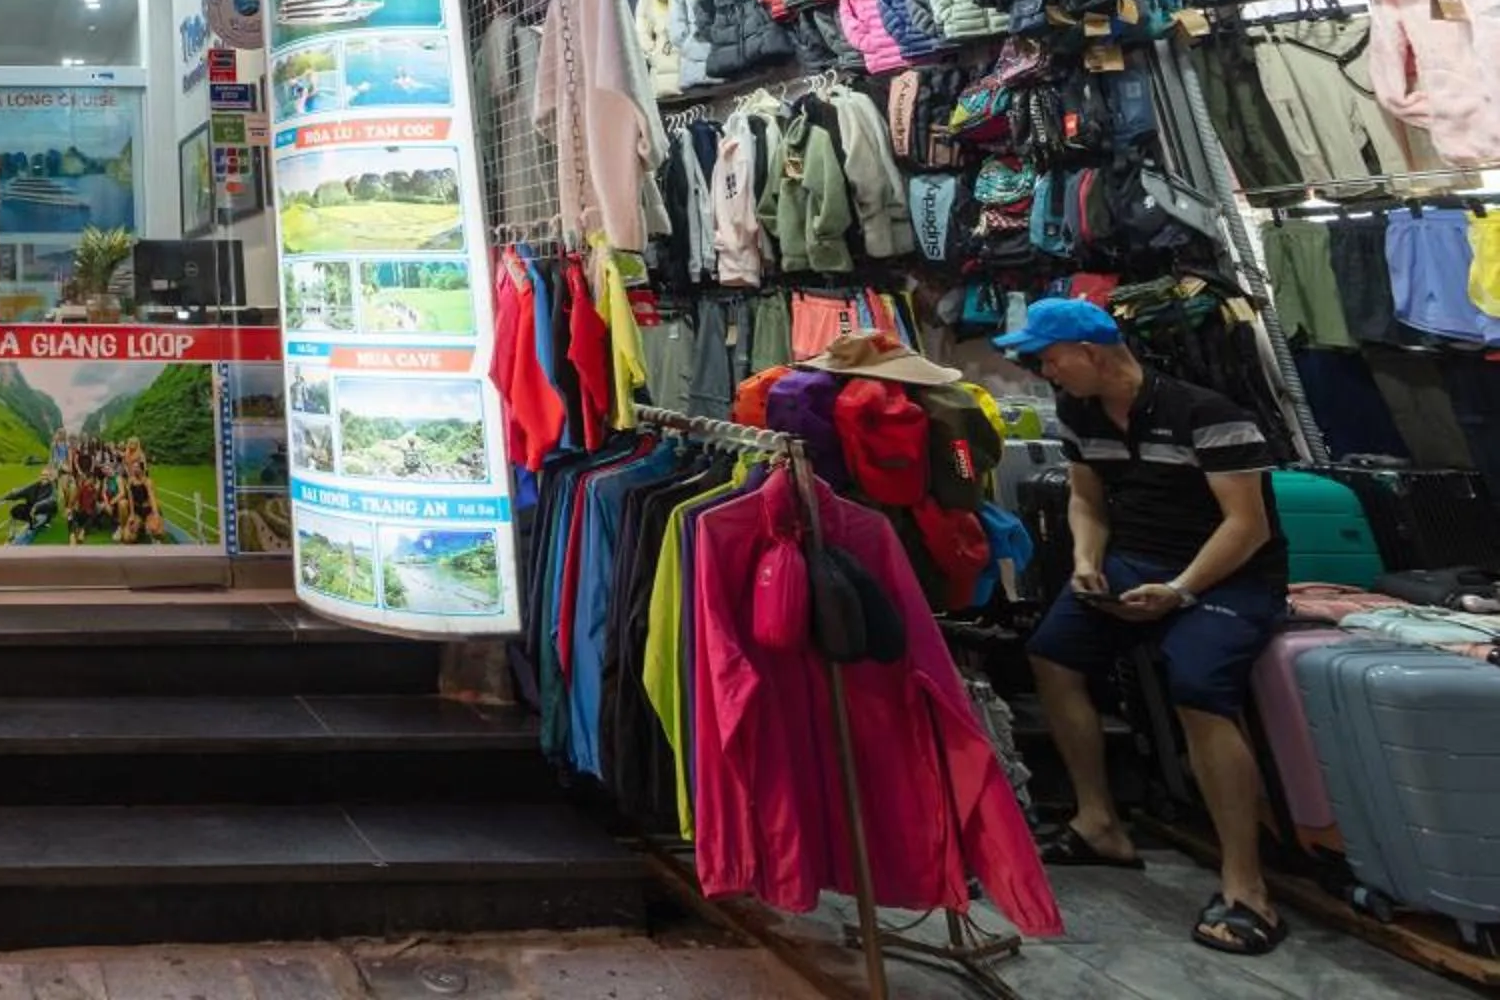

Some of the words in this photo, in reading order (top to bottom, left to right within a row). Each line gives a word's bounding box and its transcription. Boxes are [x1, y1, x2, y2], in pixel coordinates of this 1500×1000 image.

[7, 92, 53, 107] LONG
[925, 181, 943, 258] Superdry
[31, 330, 118, 358] GIANG
[126, 330, 195, 358] LOOP
[422, 500, 448, 517] AN
